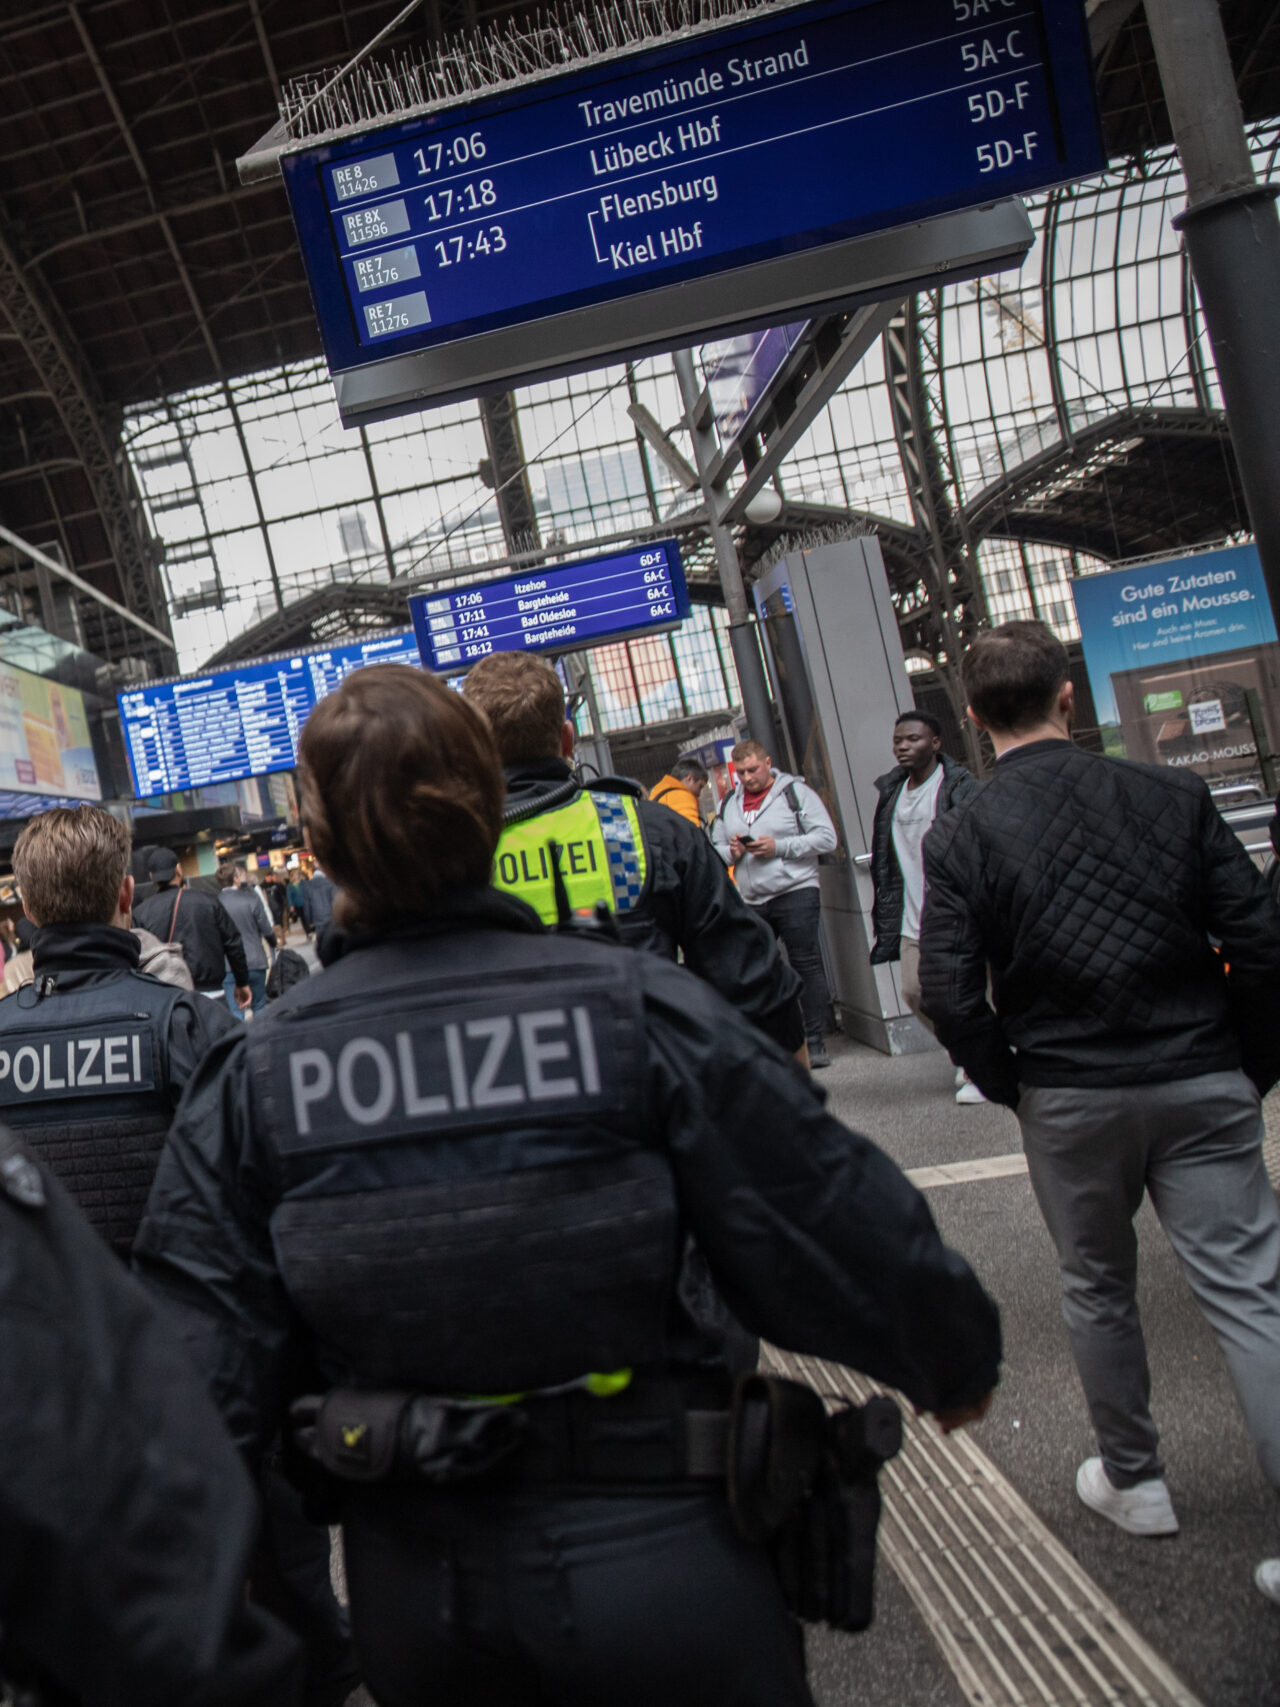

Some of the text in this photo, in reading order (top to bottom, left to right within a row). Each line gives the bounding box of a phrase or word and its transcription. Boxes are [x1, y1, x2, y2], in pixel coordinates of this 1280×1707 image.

[413, 0, 1016, 175] 17:06 Travemünde Strand 5A-
[424, 30, 1025, 222] 17:18 Lübeck Hbf 5A-C
[337, 165, 363, 183] RE 8
[340, 176, 378, 198] 11426
[435, 80, 1030, 268] 17:43 Flensburg 5D-F
[348, 209, 381, 230] RE 8X
[610, 131, 1038, 270] Kiel Hbf 5D-F
[350, 222, 388, 244] 11596
[358, 257, 383, 275] RE 7
[361, 268, 399, 289] 11176
[368, 302, 393, 320] RE 7
[372, 313, 409, 335] 11276
[455, 591, 483, 609] 17:06
[514, 579, 547, 595] Itzehoe
[640, 552, 662, 567] 6D-F
[458, 608, 486, 625] 17:11
[518, 590, 570, 612] Bargteheide
[643, 569, 665, 584] 6A-C
[1121, 570, 1237, 603] Gute Zutaten
[462, 625, 490, 641] 17:41
[521, 615, 538, 629] Bad
[540, 608, 577, 624] Oldesloe
[647, 586, 669, 600] 6A-C
[1111, 589, 1256, 627] sind ein Mousse.
[465, 641, 493, 658] 18:12
[524, 625, 576, 645] Bargteheide
[650, 602, 672, 617] 6A-C
[492, 840, 598, 885] OLIEI
[289, 1006, 602, 1136] POLIZEI
